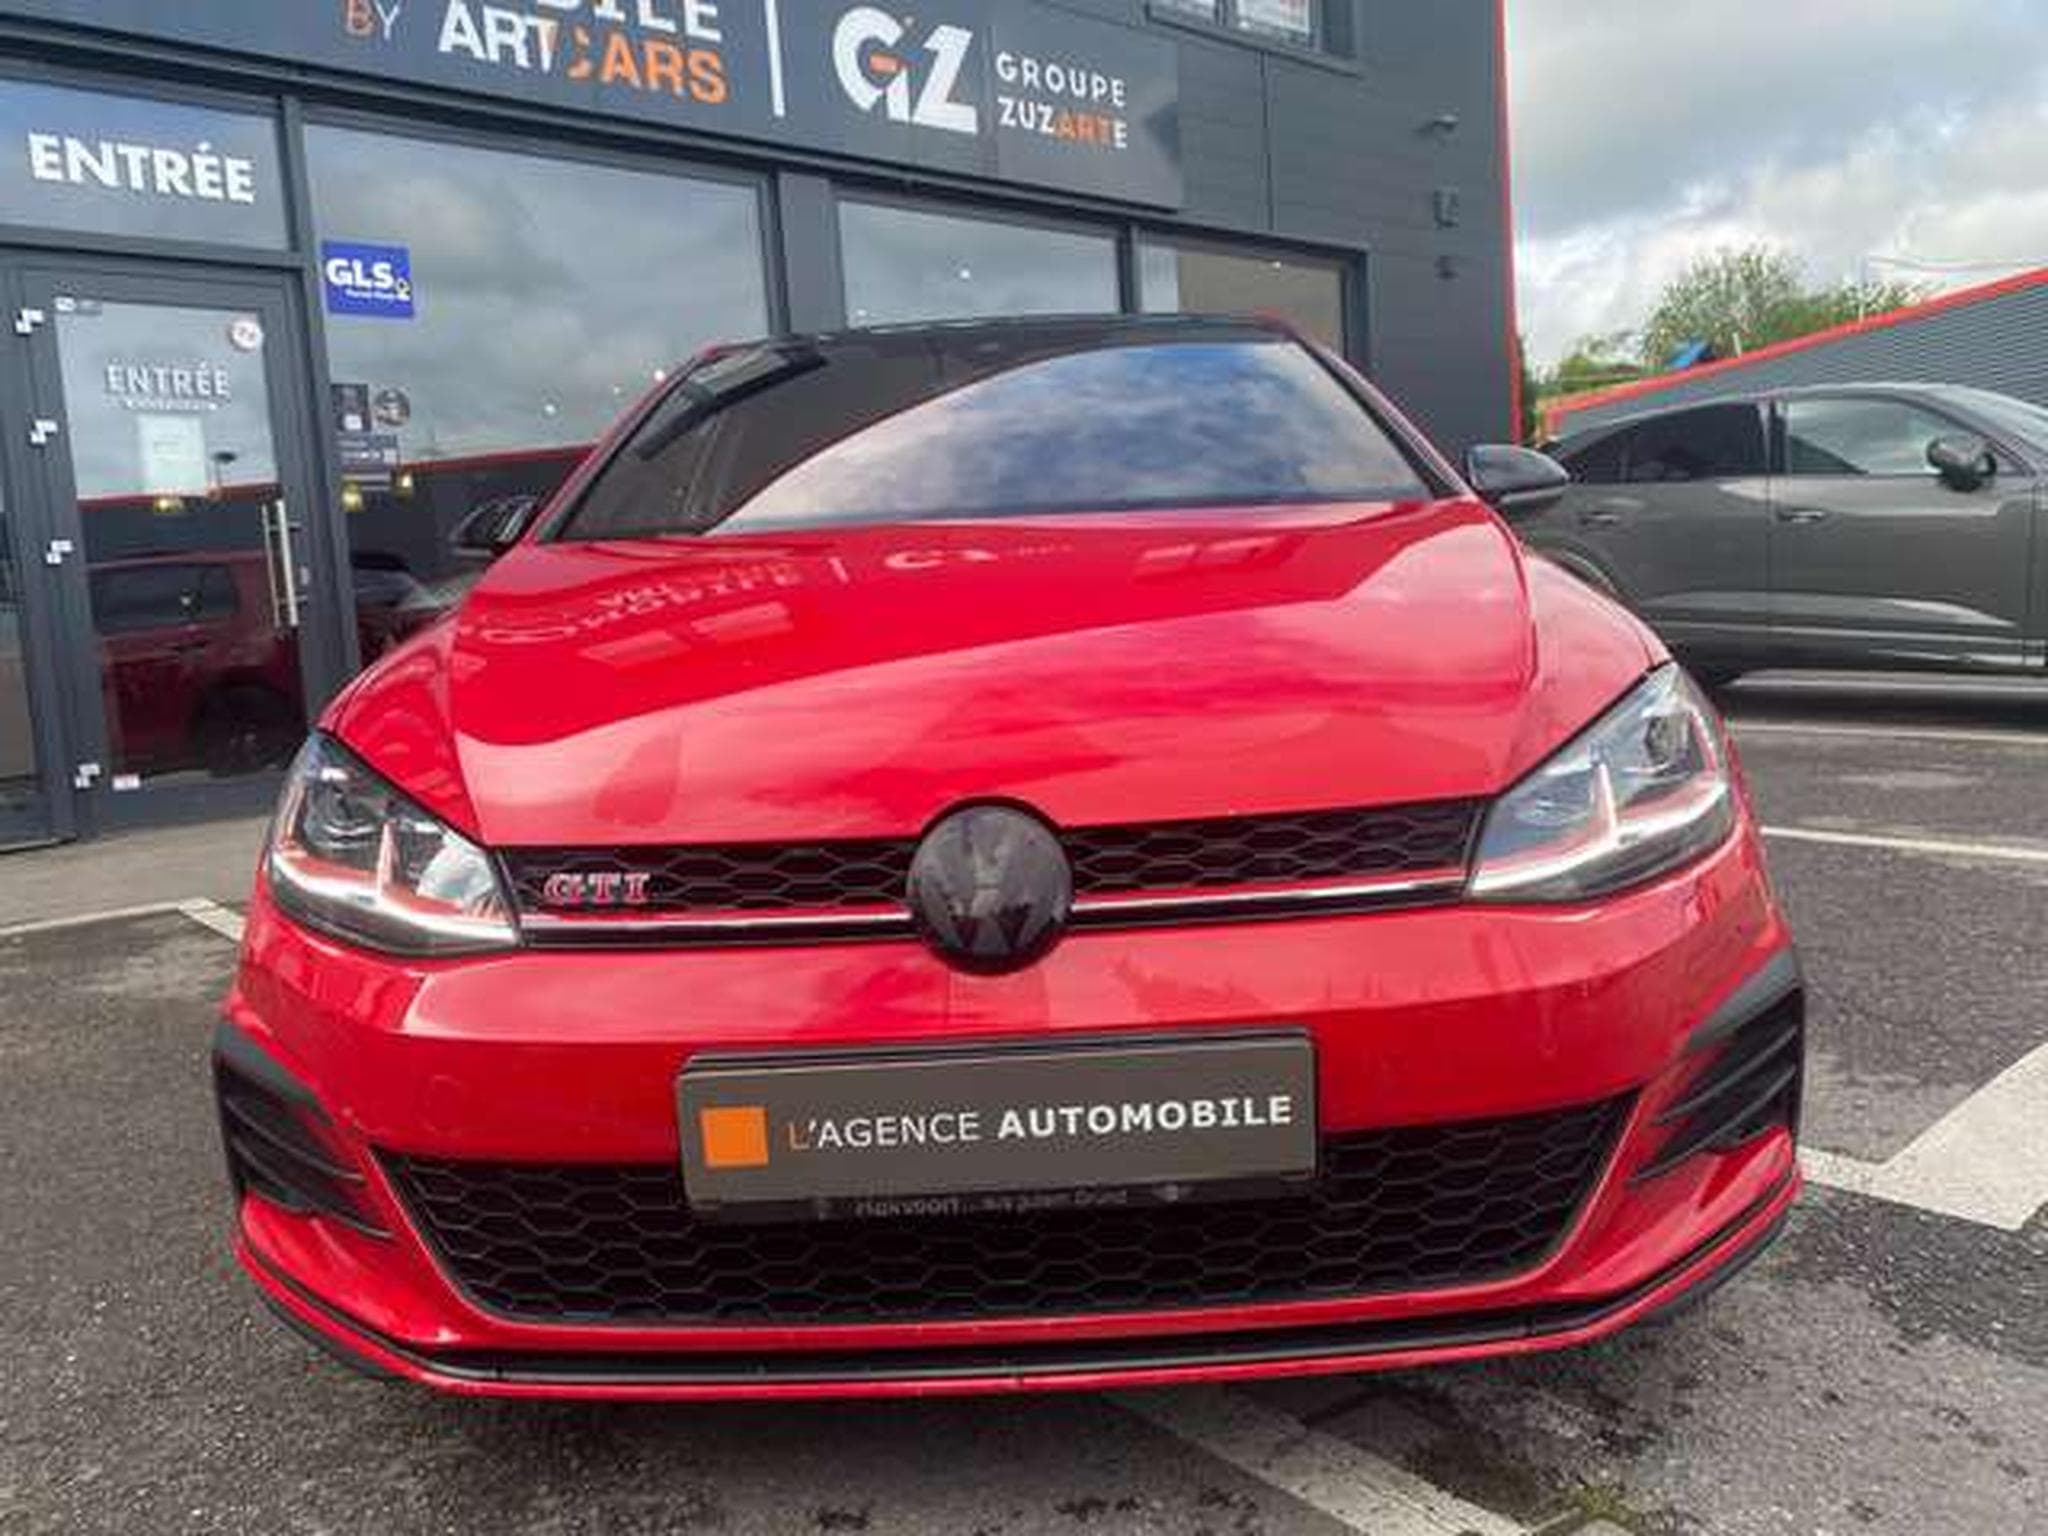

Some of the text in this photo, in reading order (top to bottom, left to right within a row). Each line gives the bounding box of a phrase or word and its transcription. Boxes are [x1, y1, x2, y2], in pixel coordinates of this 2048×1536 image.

[345, 0, 400, 40] BY
[996, 50, 1127, 106] GROUPE
[997, 97, 1128, 150] ZUZARTE
[28, 132, 255, 203] ENTRÉE
[326, 257, 394, 289] GLS
[106, 361, 233, 399] ENTRÉE
[543, 872, 651, 905] GTI
[788, 1096, 1292, 1151] L'AGENCE AUTOMOBILE
